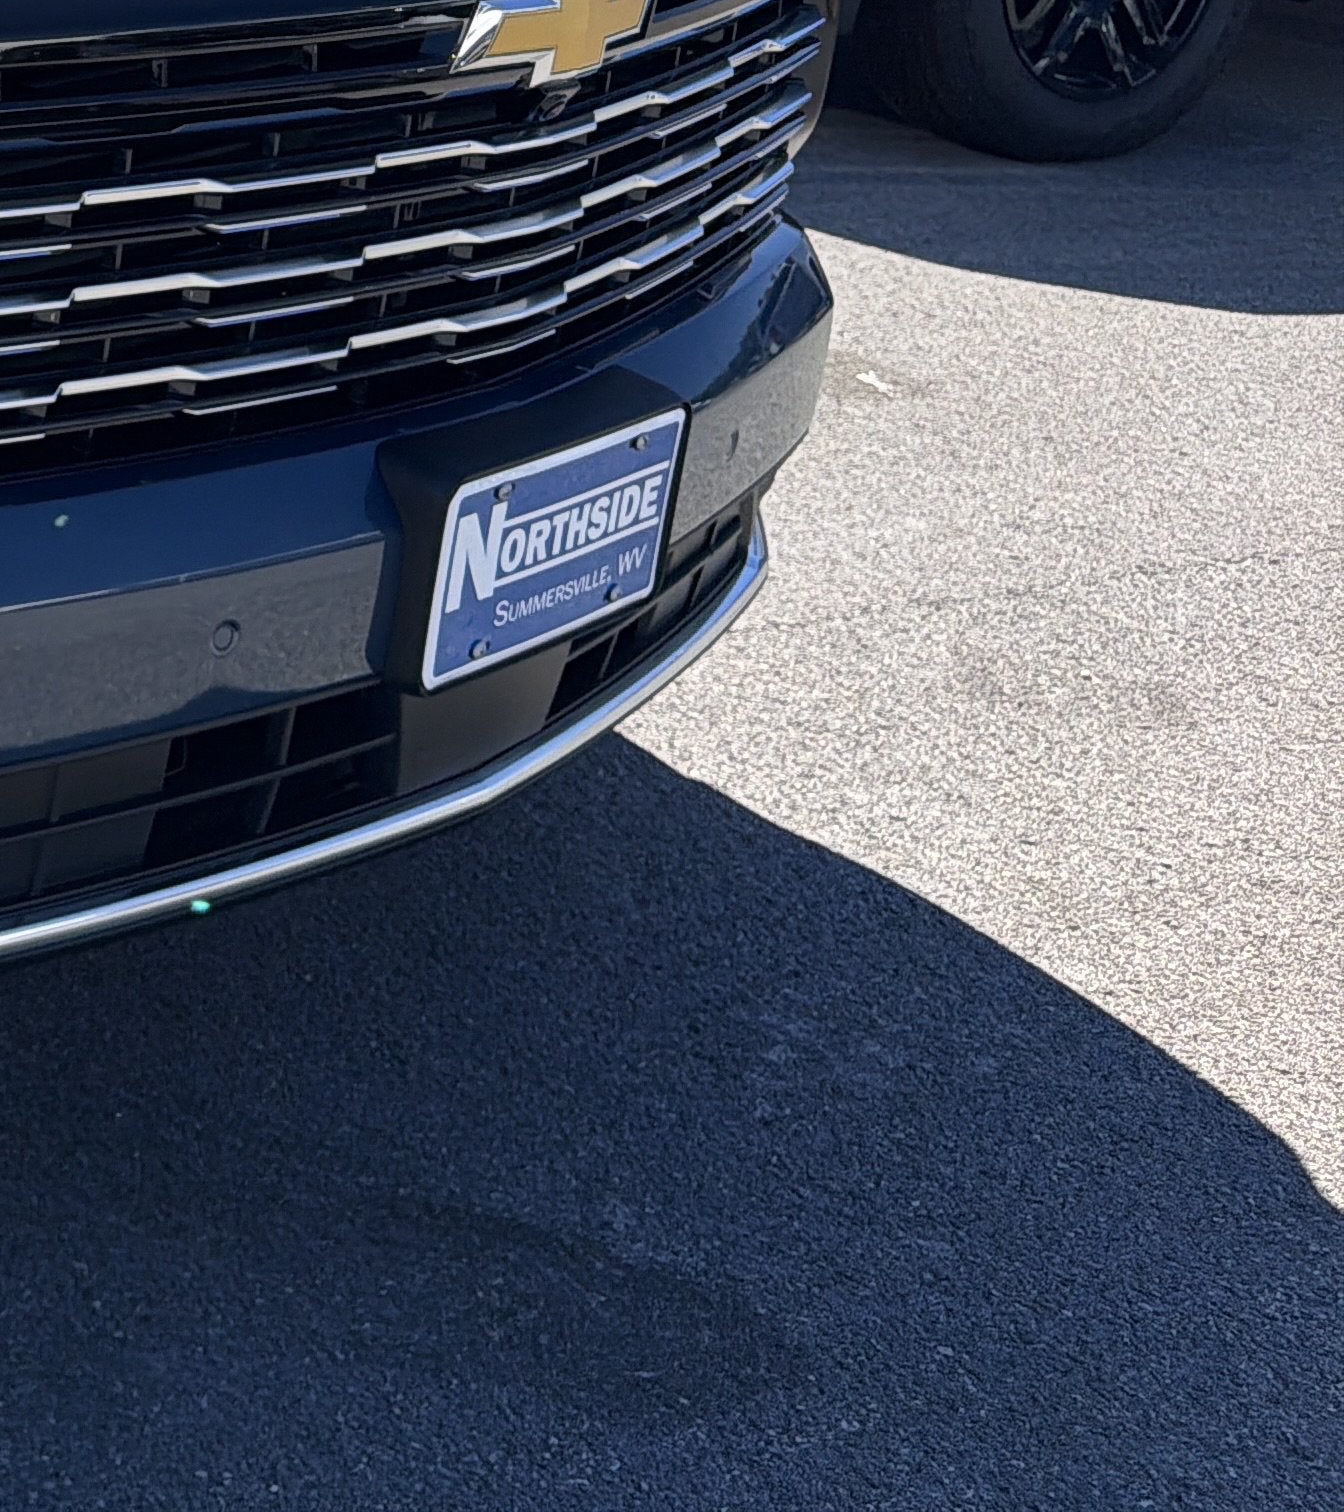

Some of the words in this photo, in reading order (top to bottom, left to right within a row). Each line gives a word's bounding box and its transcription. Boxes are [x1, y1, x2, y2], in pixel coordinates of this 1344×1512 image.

[445, 474, 663, 614] NORTHSIDE
[493, 565, 612, 627] SUMMERSVILLE,
[618, 544, 648, 577] WV
